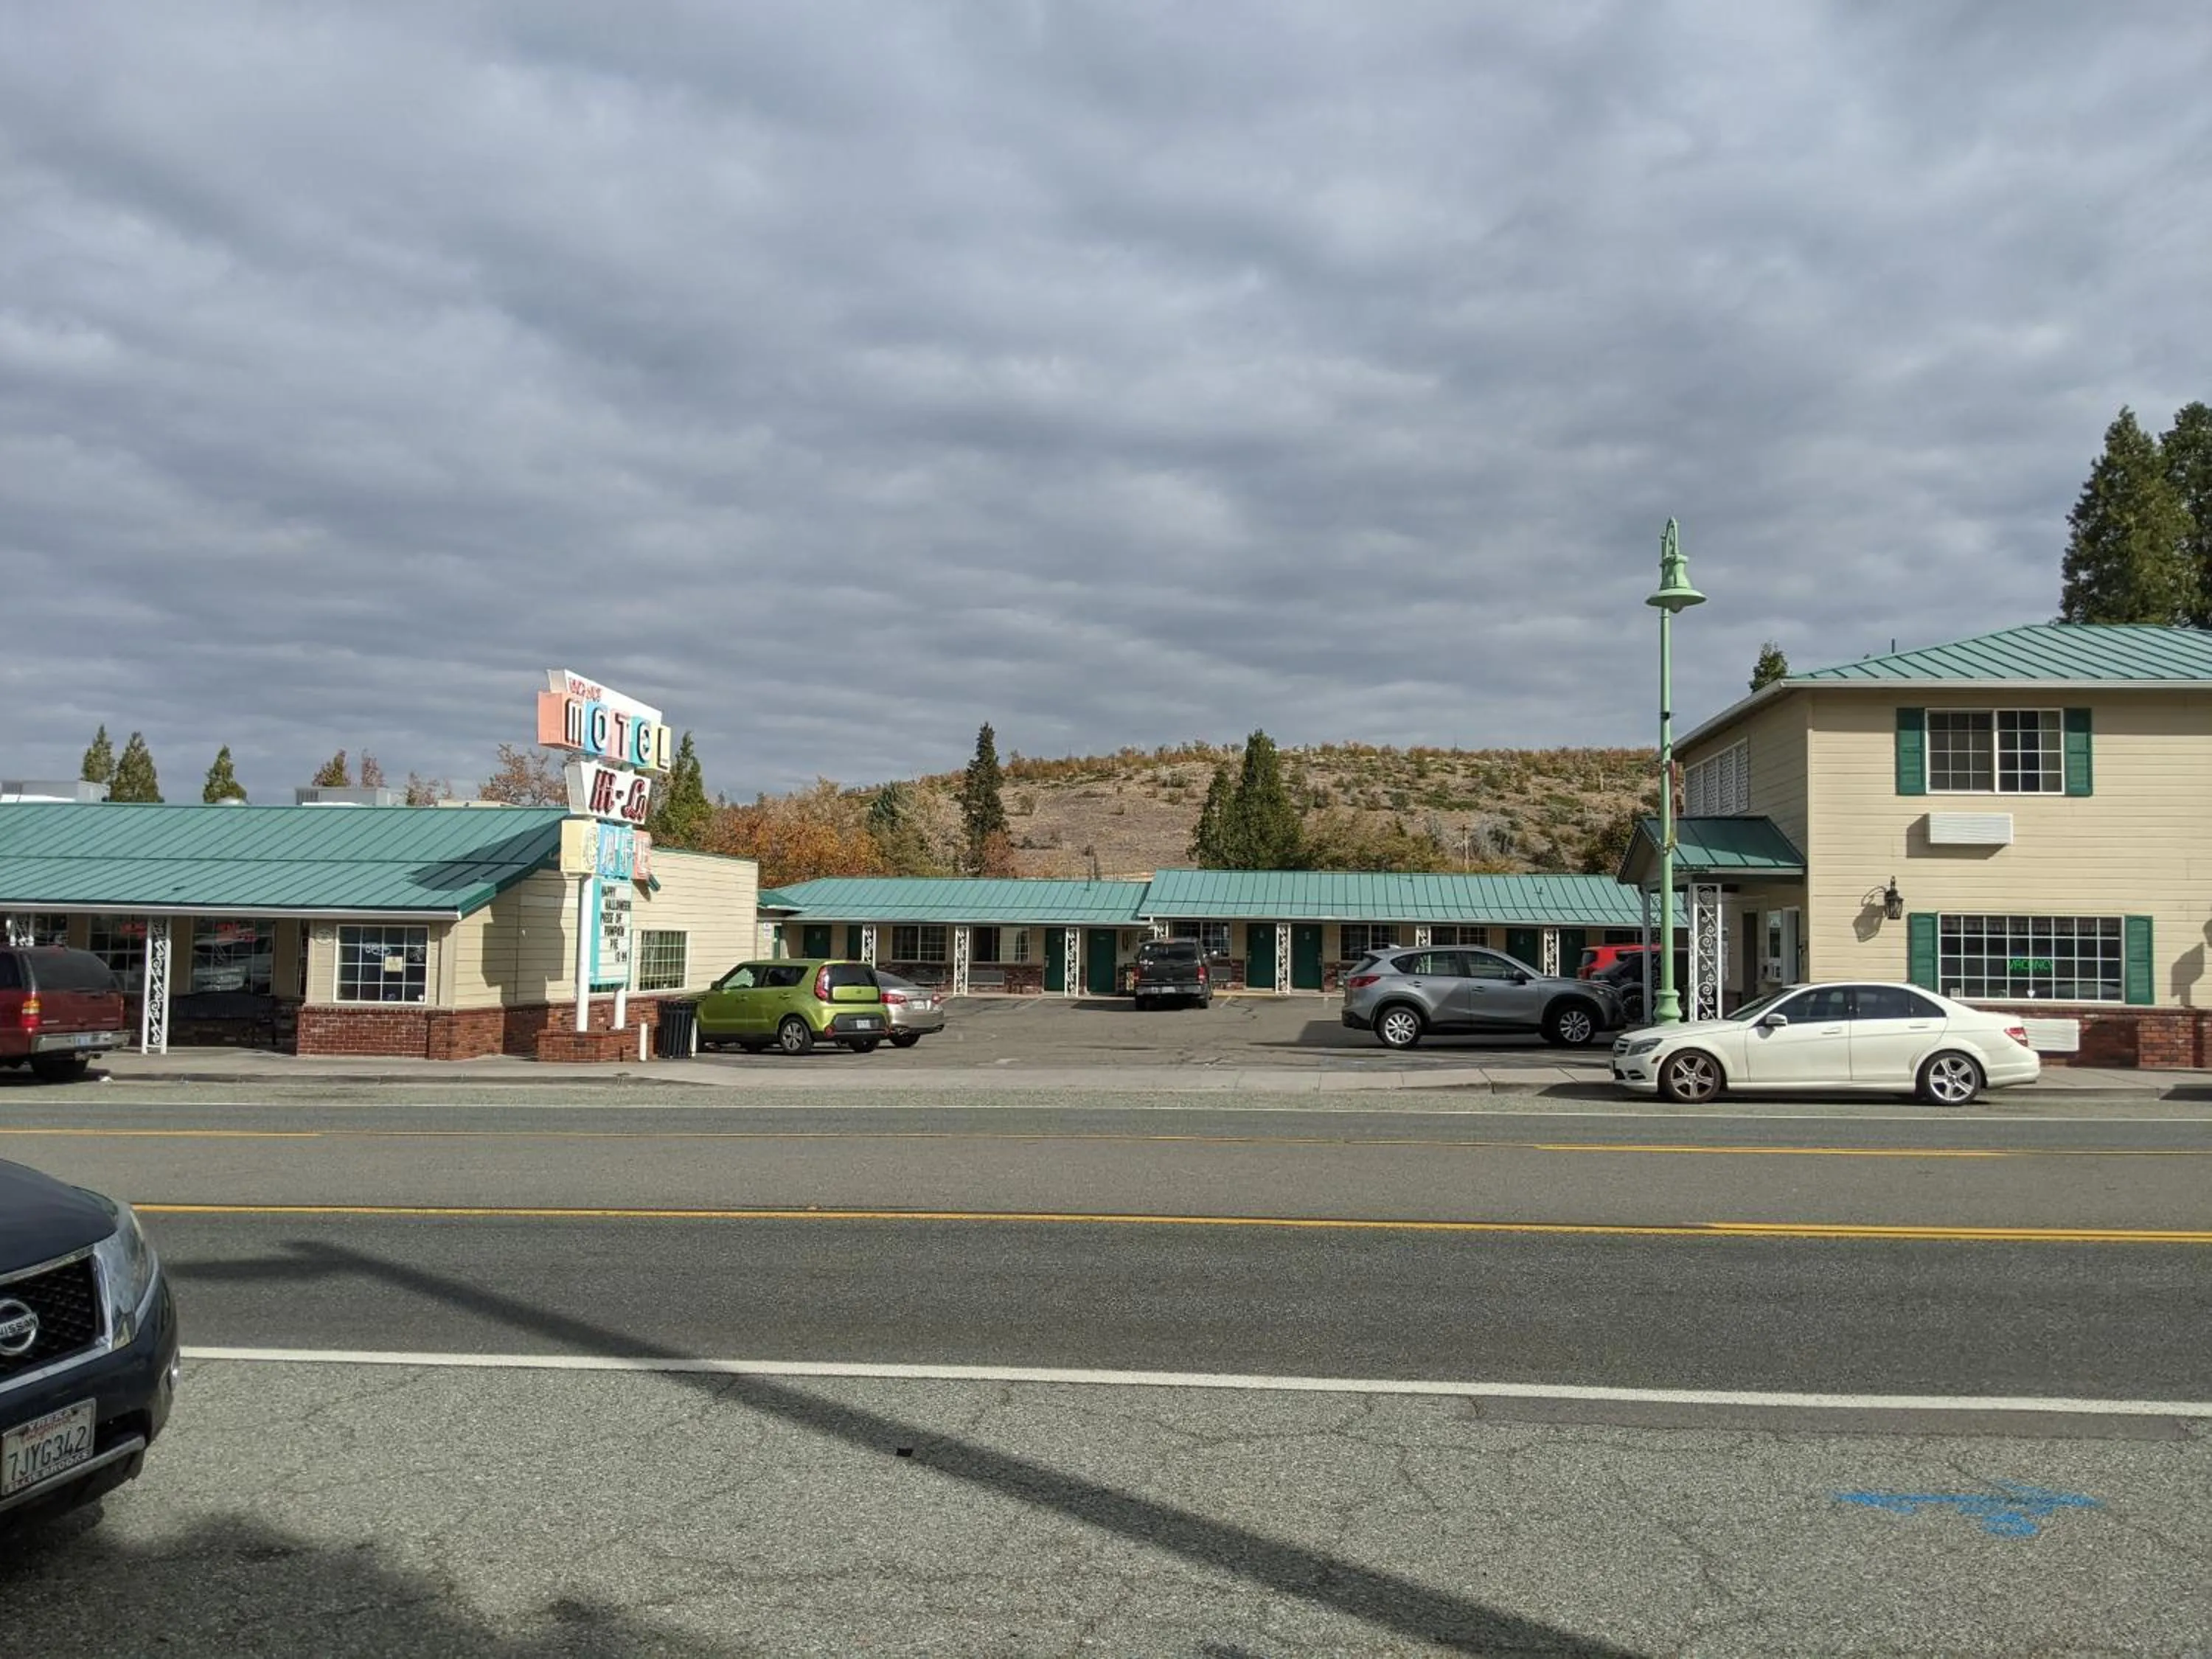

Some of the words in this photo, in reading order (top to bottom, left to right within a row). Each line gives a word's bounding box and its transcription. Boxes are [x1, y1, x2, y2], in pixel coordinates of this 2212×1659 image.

[565, 698, 669, 770] MOTEL
[601, 886, 616, 897] HAPPY
[8, 1425, 86, 1482] 7JYG342
